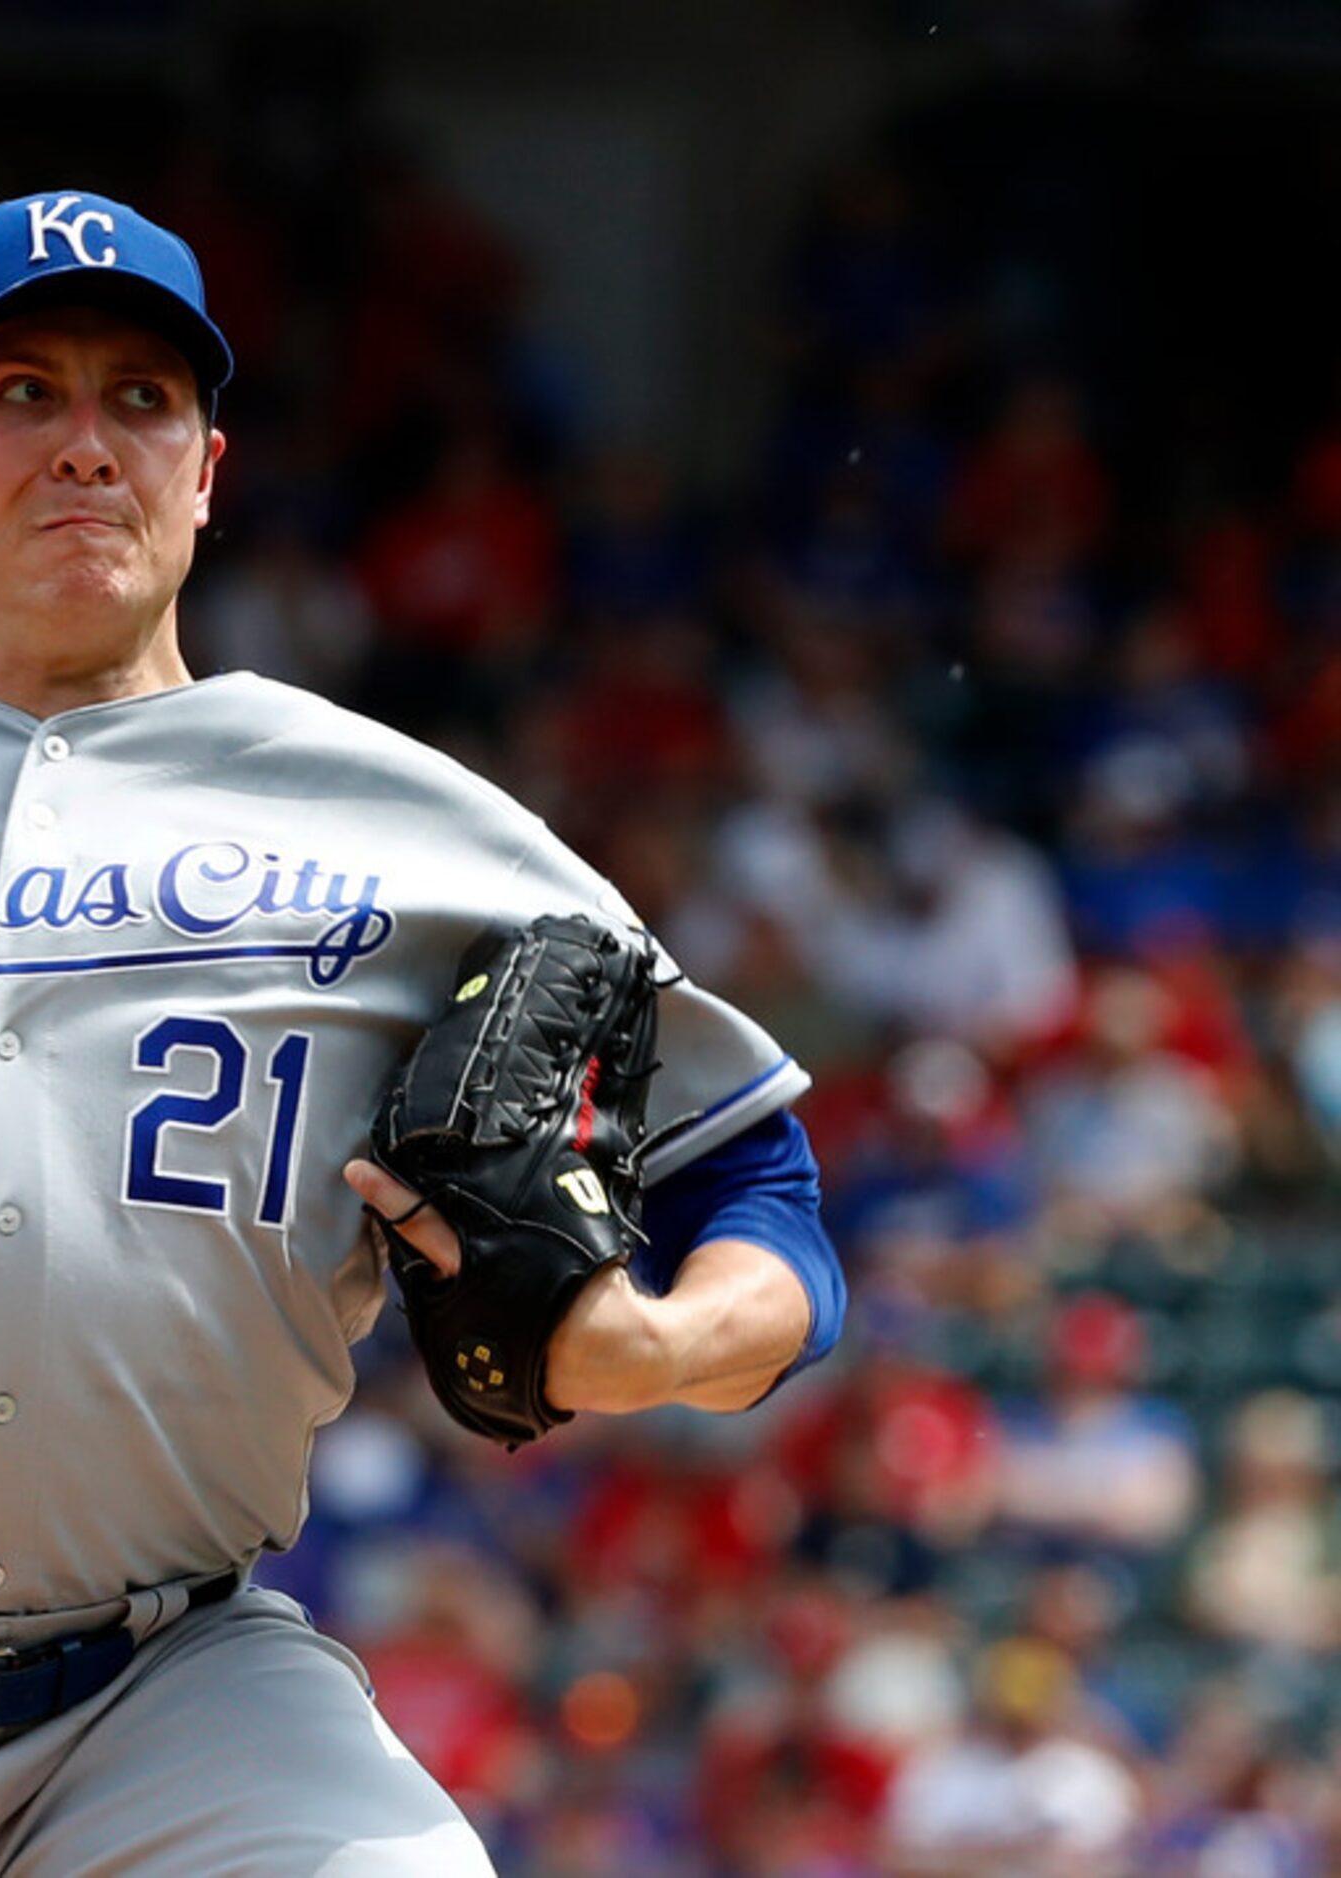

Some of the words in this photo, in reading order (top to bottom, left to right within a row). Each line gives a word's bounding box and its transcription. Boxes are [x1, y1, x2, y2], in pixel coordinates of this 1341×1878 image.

[26, 195, 117, 267] KC
[155, 840, 395, 988] City
[120, 1013, 313, 1229] 21
